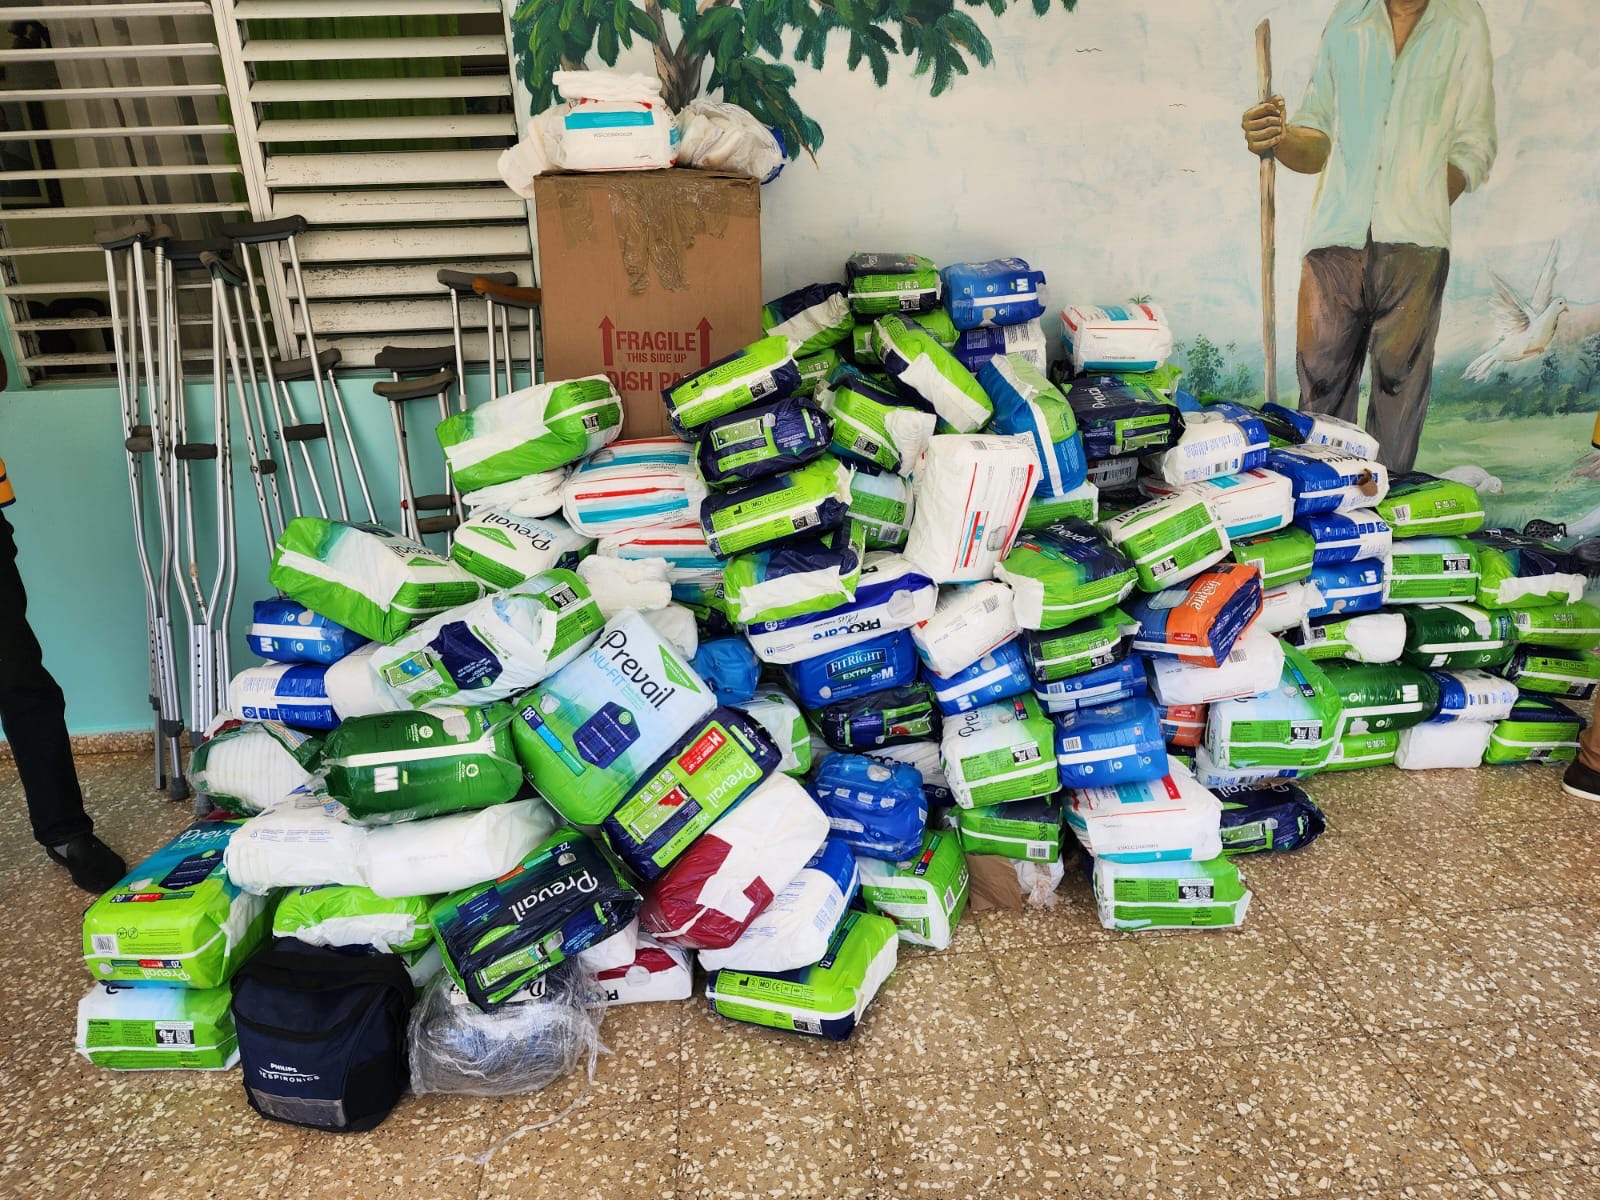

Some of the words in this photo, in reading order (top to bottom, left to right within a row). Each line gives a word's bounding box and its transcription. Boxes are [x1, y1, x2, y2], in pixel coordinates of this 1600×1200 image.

[616, 331, 696, 351] FRAGILE
[626, 353, 648, 362] THIS
[650, 353, 672, 363] SIDE
[674, 353, 687, 363] UP
[607, 371, 653, 391] DISH
[659, 372, 691, 391] PA
[482, 513, 551, 551] Prevail
[1047, 524, 1097, 544] Prevail
[813, 618, 881, 640] PROCare
[589, 650, 626, 686] NU-FIT
[600, 630, 675, 708] Prevail
[843, 667, 873, 680] EXTRA
[522, 707, 535, 720] 18
[708, 731, 723, 746] M
[706, 762, 757, 809] Prevail
[509, 870, 598, 921] Prevail
[143, 968, 191, 980] Prevail
[270, 1062, 298, 1073] PHILIPS
